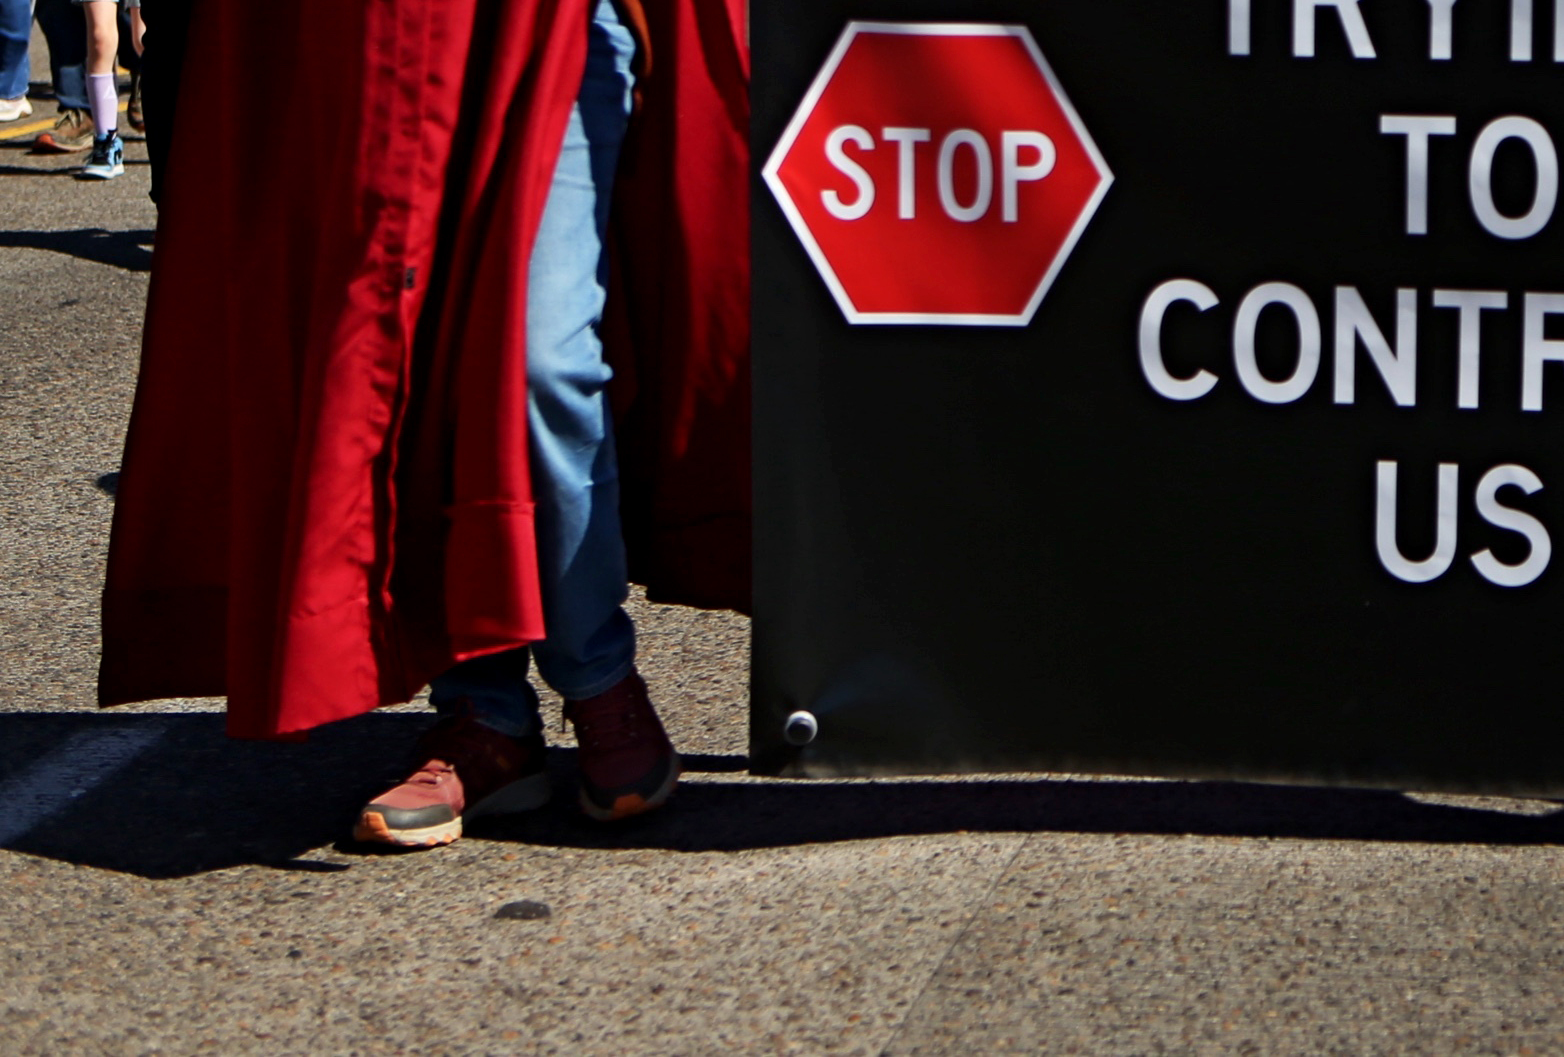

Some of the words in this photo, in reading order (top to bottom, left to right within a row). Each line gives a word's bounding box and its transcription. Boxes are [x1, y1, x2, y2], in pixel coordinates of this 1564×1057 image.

[821, 125, 1055, 221] STOP
[1381, 116, 1557, 238] TO
[1377, 461, 1551, 586] US
